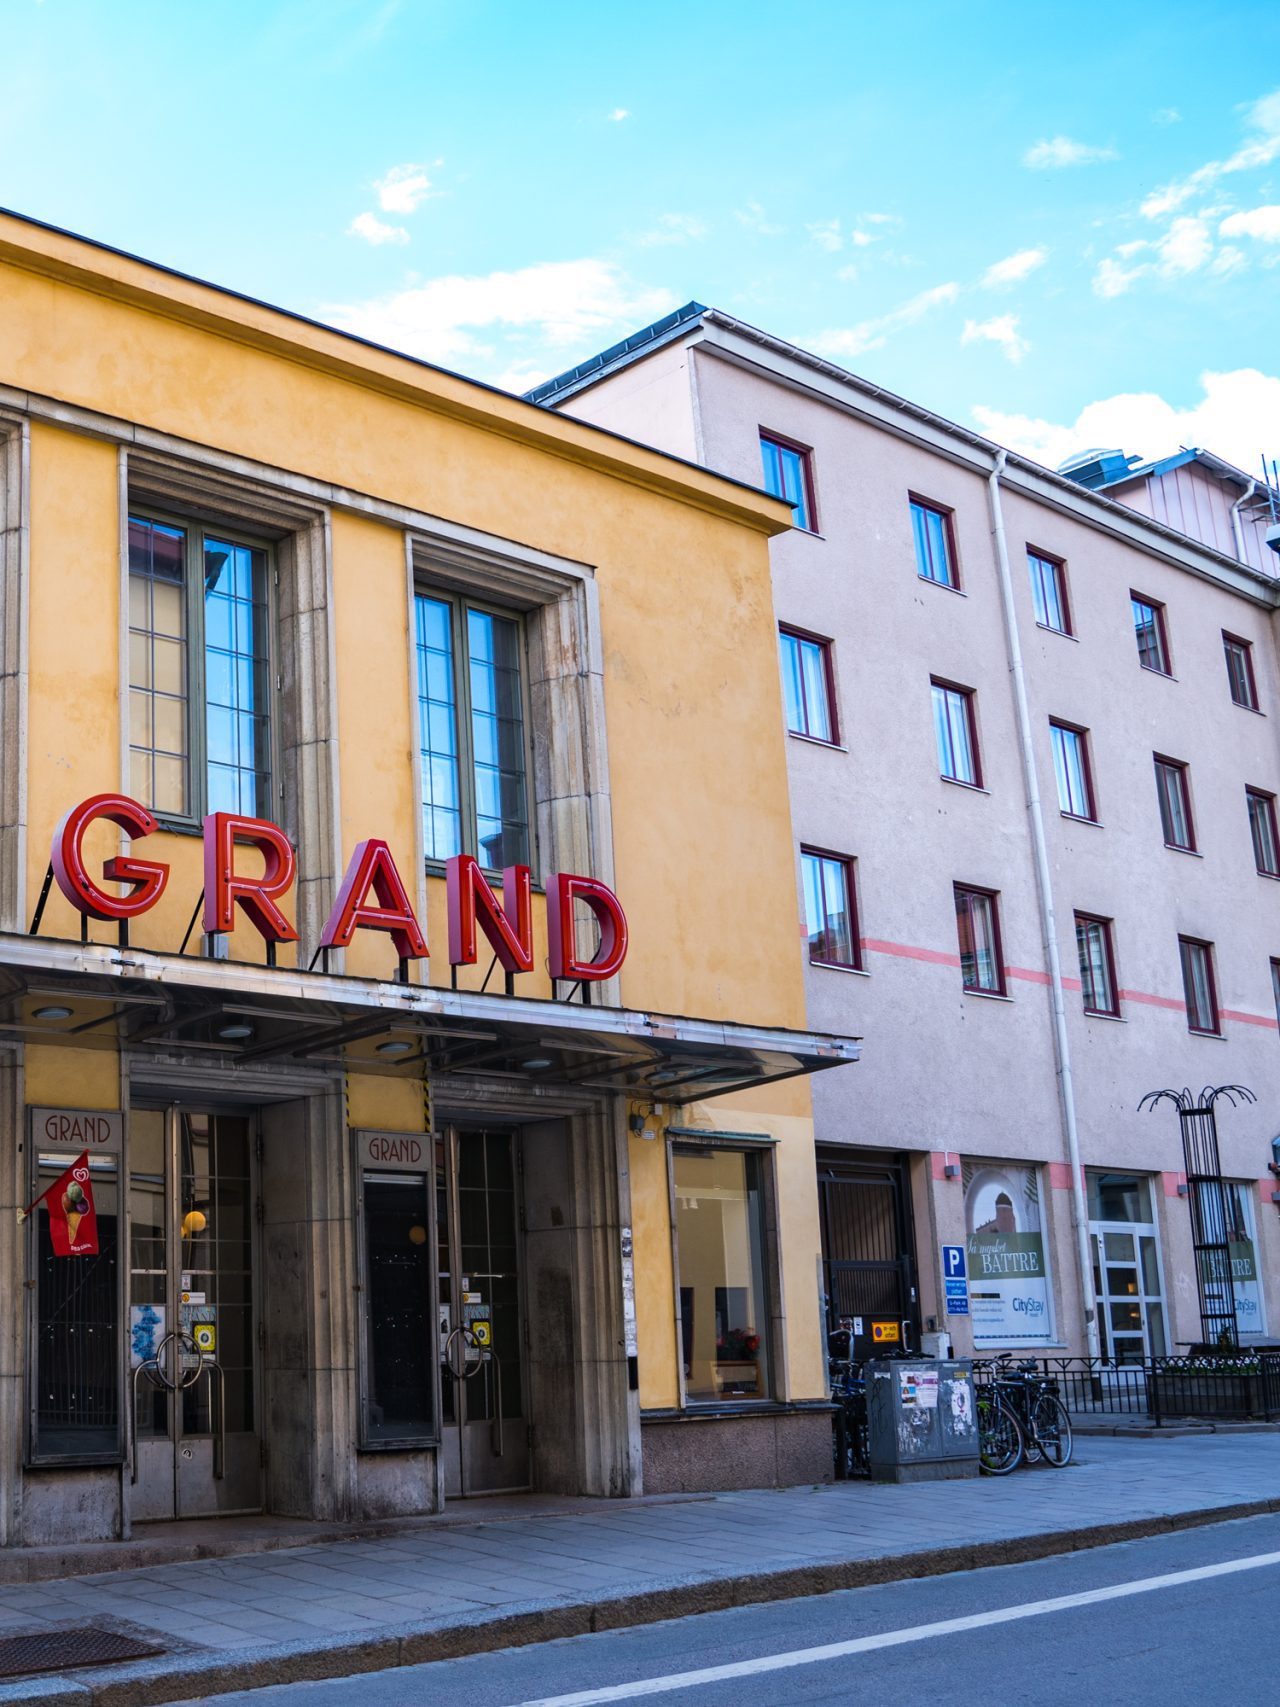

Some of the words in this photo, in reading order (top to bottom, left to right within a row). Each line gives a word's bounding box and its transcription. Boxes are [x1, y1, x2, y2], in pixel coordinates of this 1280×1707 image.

[51, 792, 629, 982] GRAND
[45, 1115, 111, 1143] GRAND
[369, 1137, 422, 1163] GRAND
[948, 1249, 960, 1275] P
[1012, 1297, 1044, 1315] CityStay
